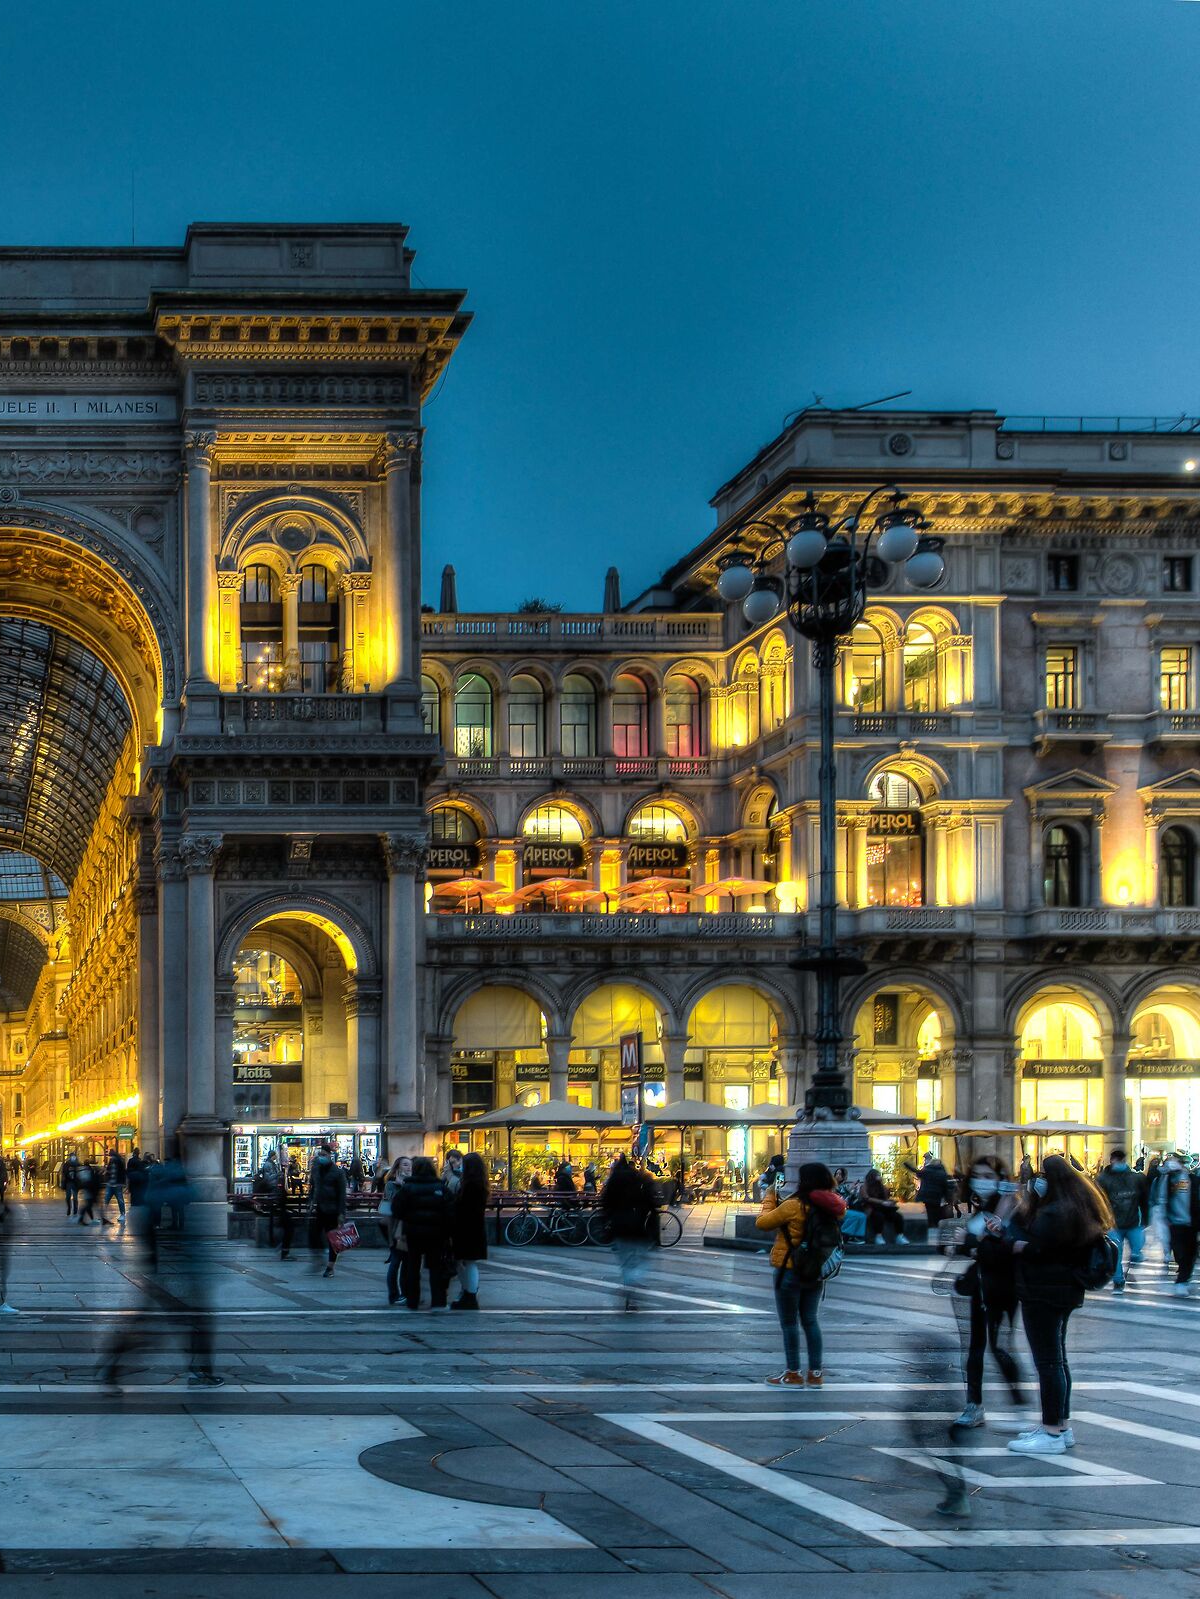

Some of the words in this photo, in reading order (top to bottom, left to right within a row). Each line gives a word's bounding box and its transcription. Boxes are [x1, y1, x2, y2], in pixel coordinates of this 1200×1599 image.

[87, 402, 158, 413] MILANESI
[871, 814, 915, 828] PEROL
[523, 846, 574, 862] APEROL
[628, 846, 678, 861] APEROL
[622, 1042, 637, 1068] M
[237, 1067, 272, 1078] Motta
[450, 1064, 468, 1077] tta
